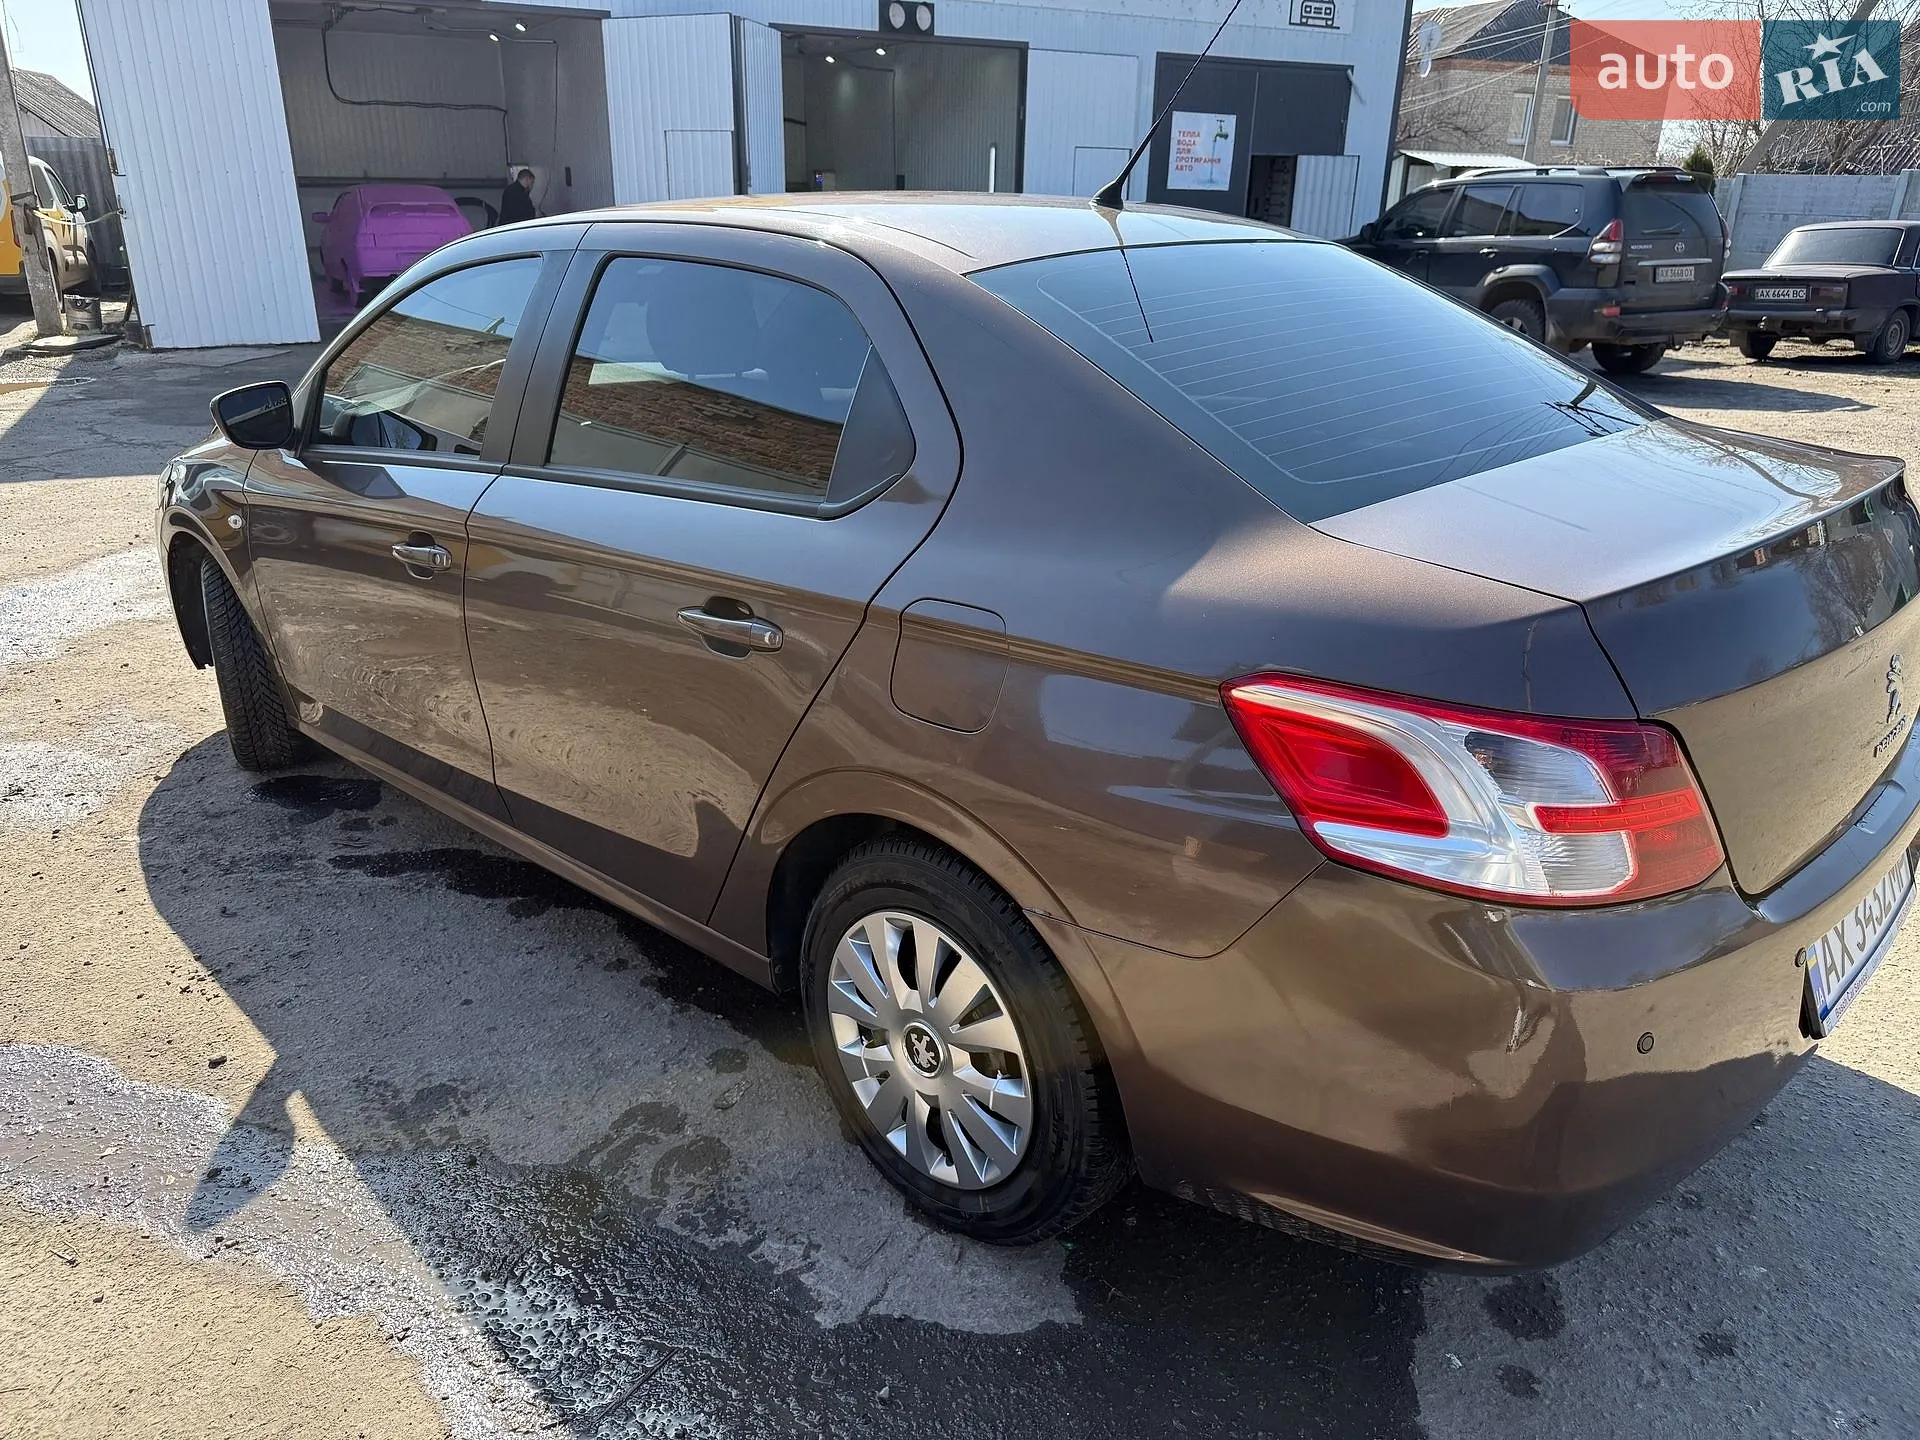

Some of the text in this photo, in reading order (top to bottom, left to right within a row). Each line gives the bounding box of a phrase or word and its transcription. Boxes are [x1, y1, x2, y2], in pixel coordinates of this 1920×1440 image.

[1760, 289, 1804, 298] AX 6644 BC
[1821, 919, 1855, 996] AX
